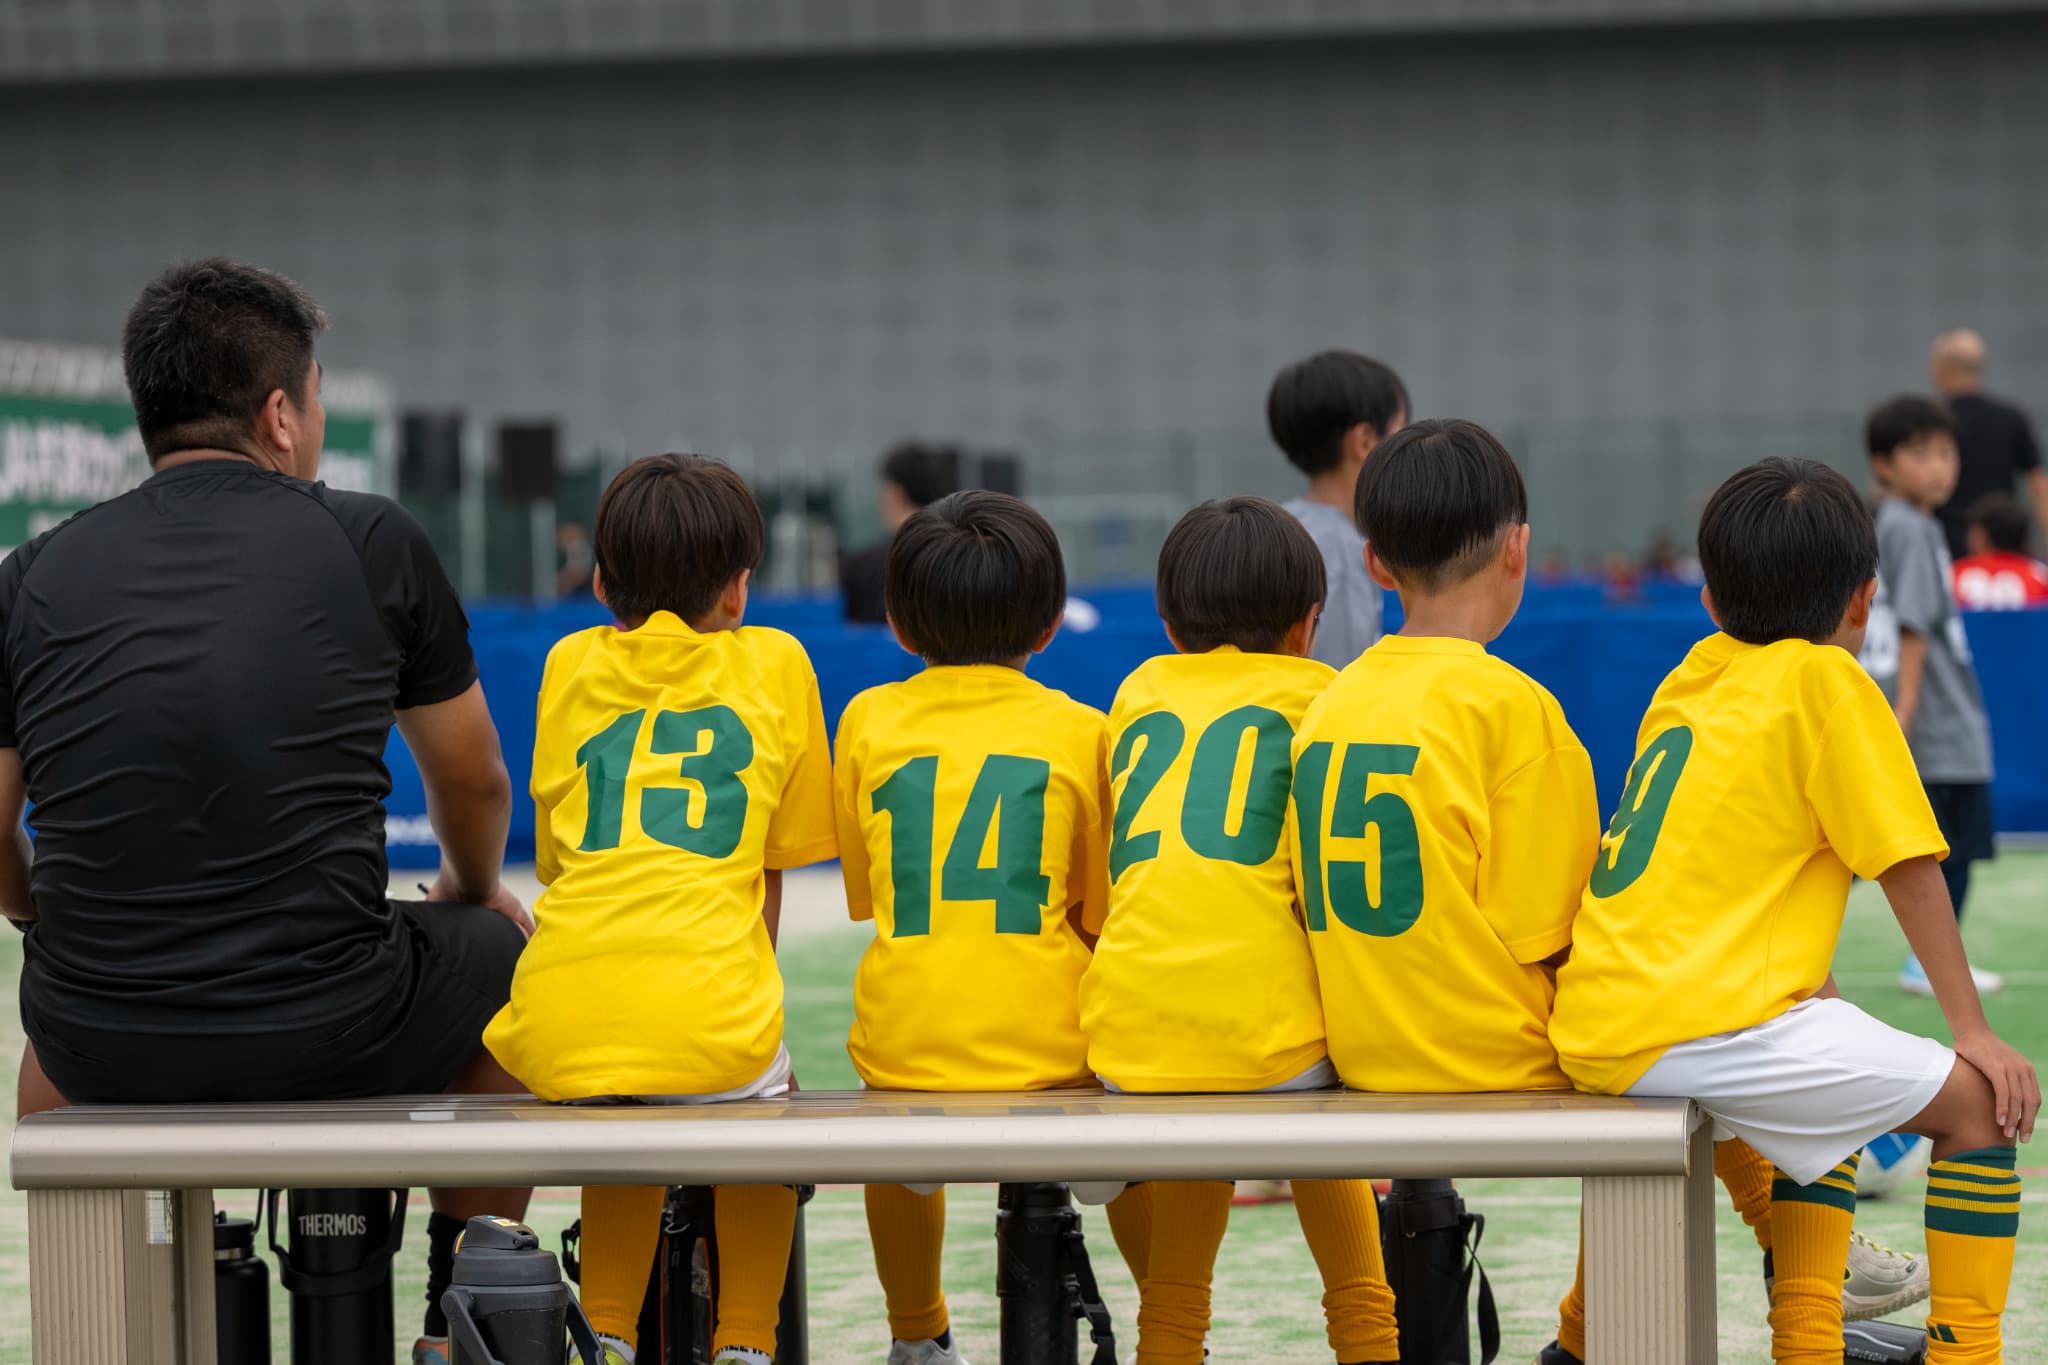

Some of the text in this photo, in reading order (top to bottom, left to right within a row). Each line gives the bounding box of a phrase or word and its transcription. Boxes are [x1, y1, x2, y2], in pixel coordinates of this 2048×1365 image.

[577, 705, 753, 858] 13
[871, 754, 1050, 938] 14
[1109, 704, 1296, 887] 20
[1291, 741, 1425, 938] 15
[298, 1213, 367, 1237] THERMOS
